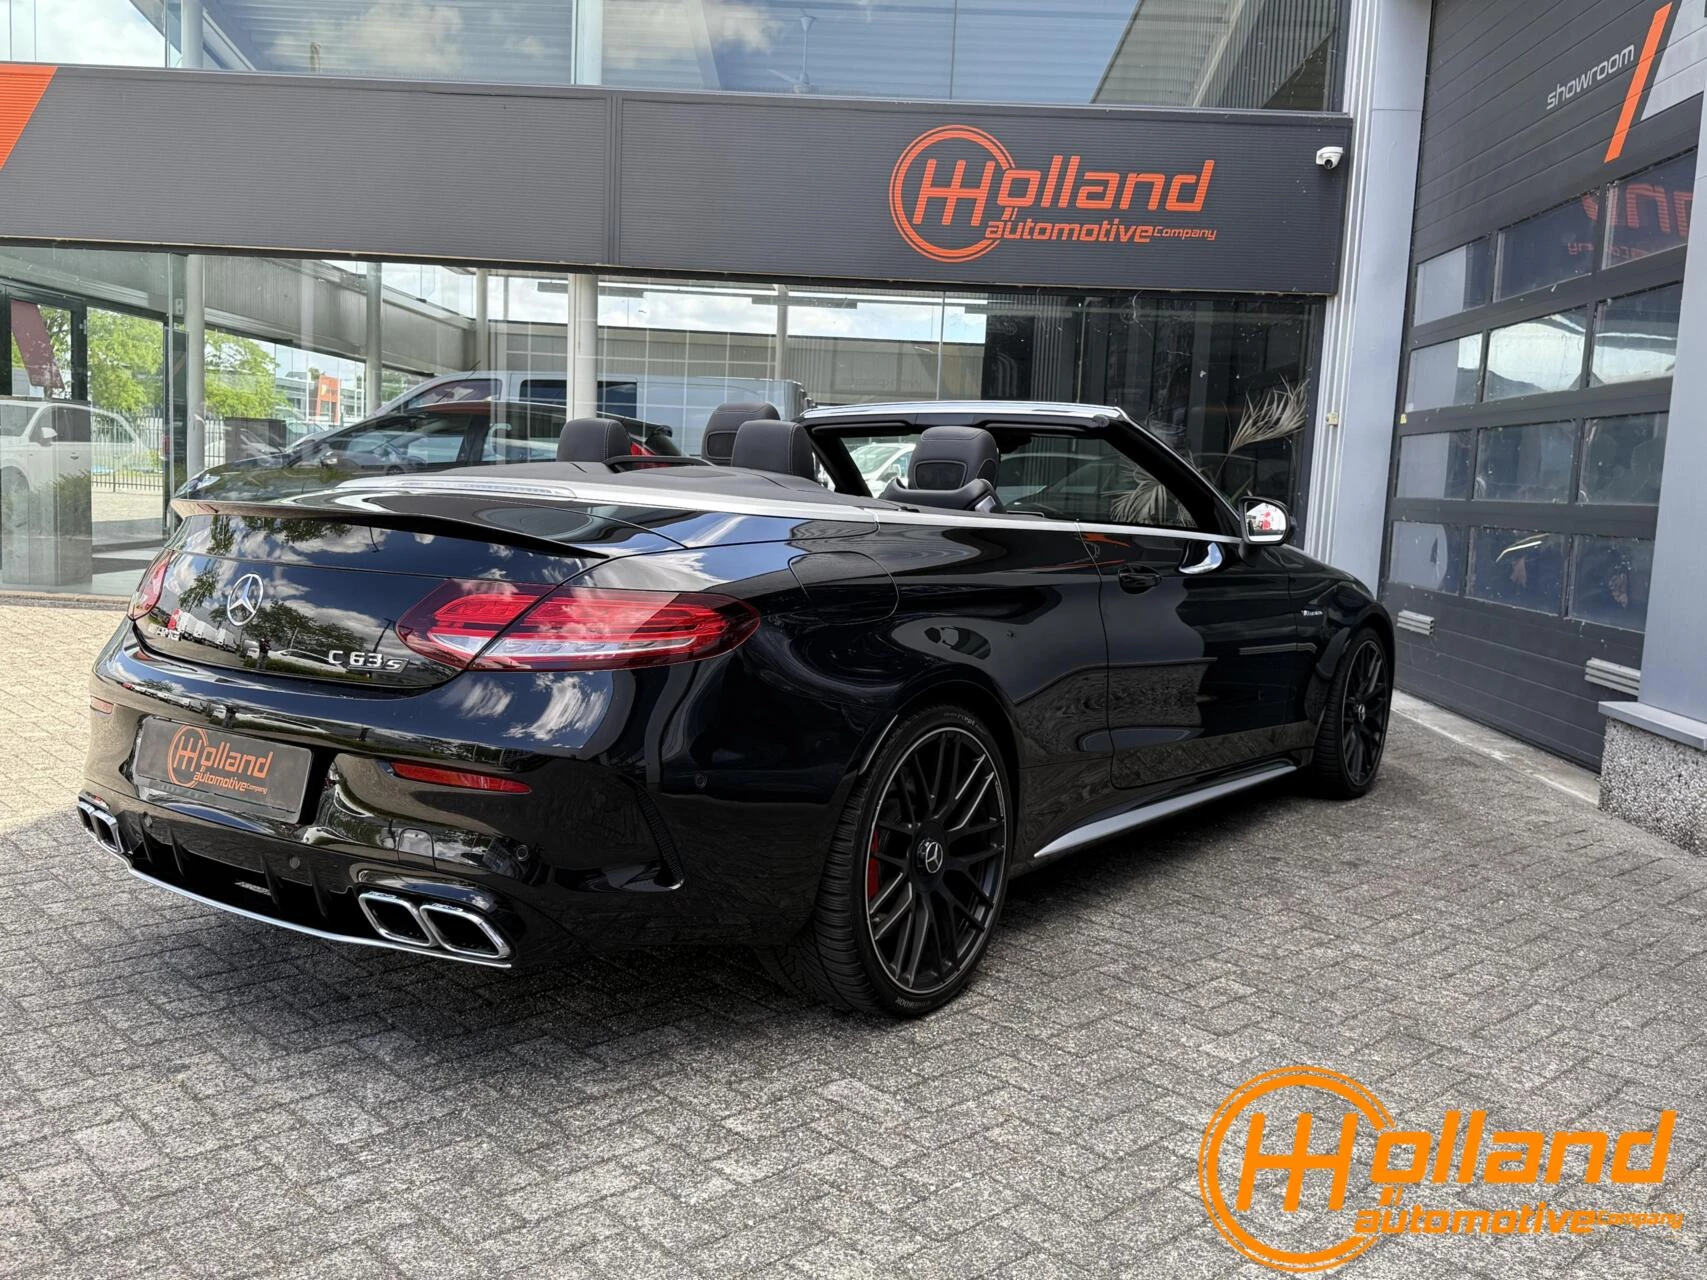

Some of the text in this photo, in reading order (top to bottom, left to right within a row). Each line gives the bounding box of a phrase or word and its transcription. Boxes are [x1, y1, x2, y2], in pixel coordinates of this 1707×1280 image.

[1546, 44, 1635, 110] showroom
[911, 155, 1215, 227] Holland
[985, 218, 1217, 243] automotive Company
[173, 736, 273, 778] Holland
[193, 771, 246, 791] automotive
